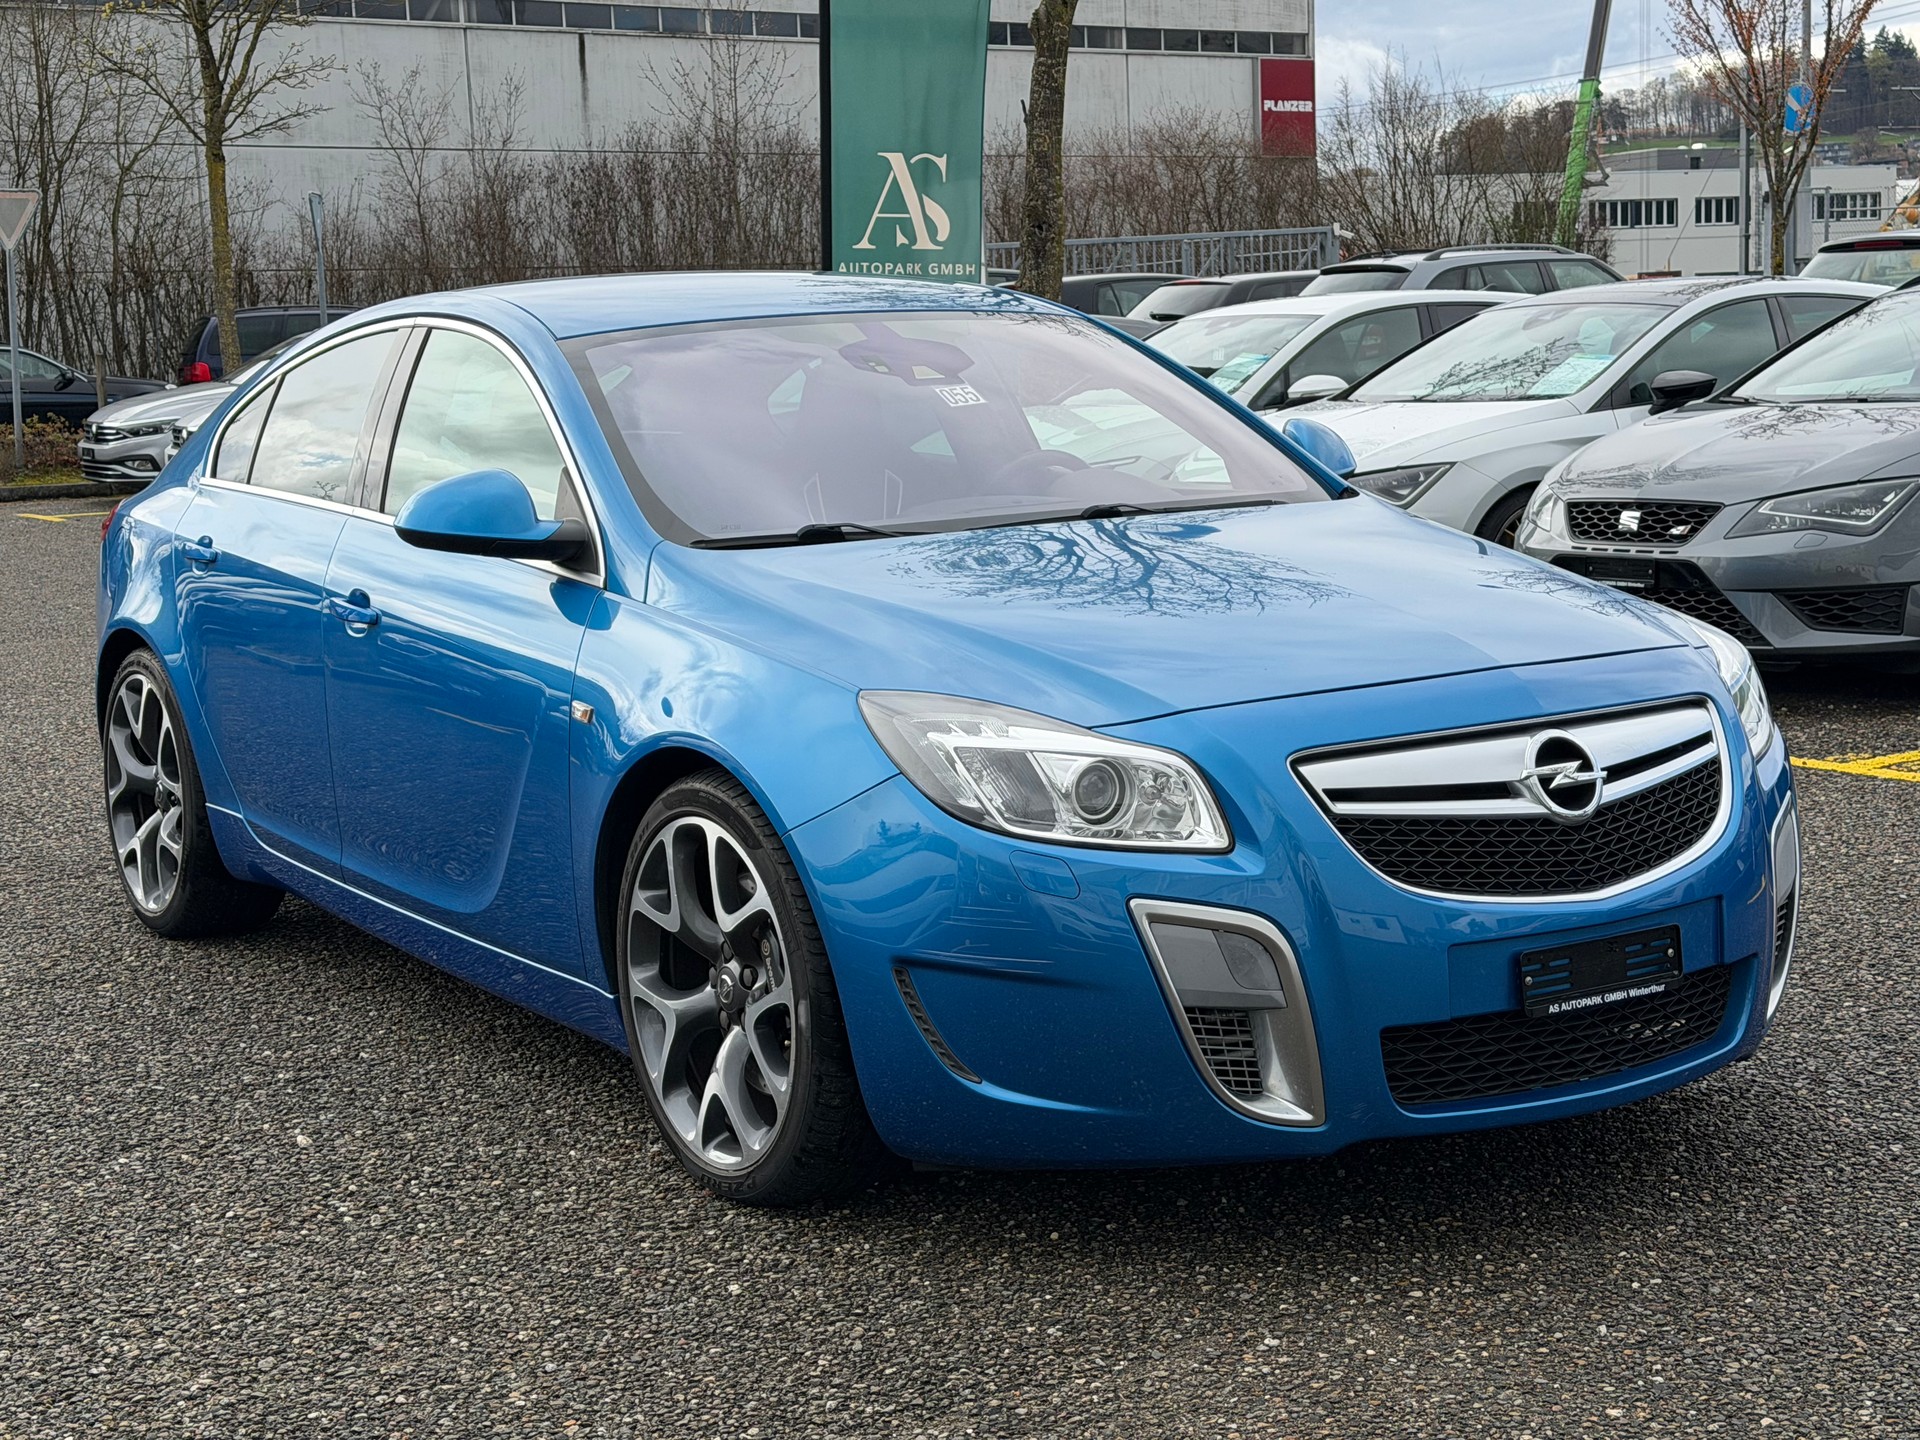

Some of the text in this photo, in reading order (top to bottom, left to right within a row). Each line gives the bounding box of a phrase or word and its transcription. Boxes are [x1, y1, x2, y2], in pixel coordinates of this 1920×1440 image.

[1263, 99, 1313, 112] PLANZER
[852, 152, 950, 250] AS
[838, 262, 976, 275] AUTOPARK GMBH
[939, 387, 981, 405] 055
[1548, 984, 1666, 1014] AS AUTOPARK GMBH Winterthur
